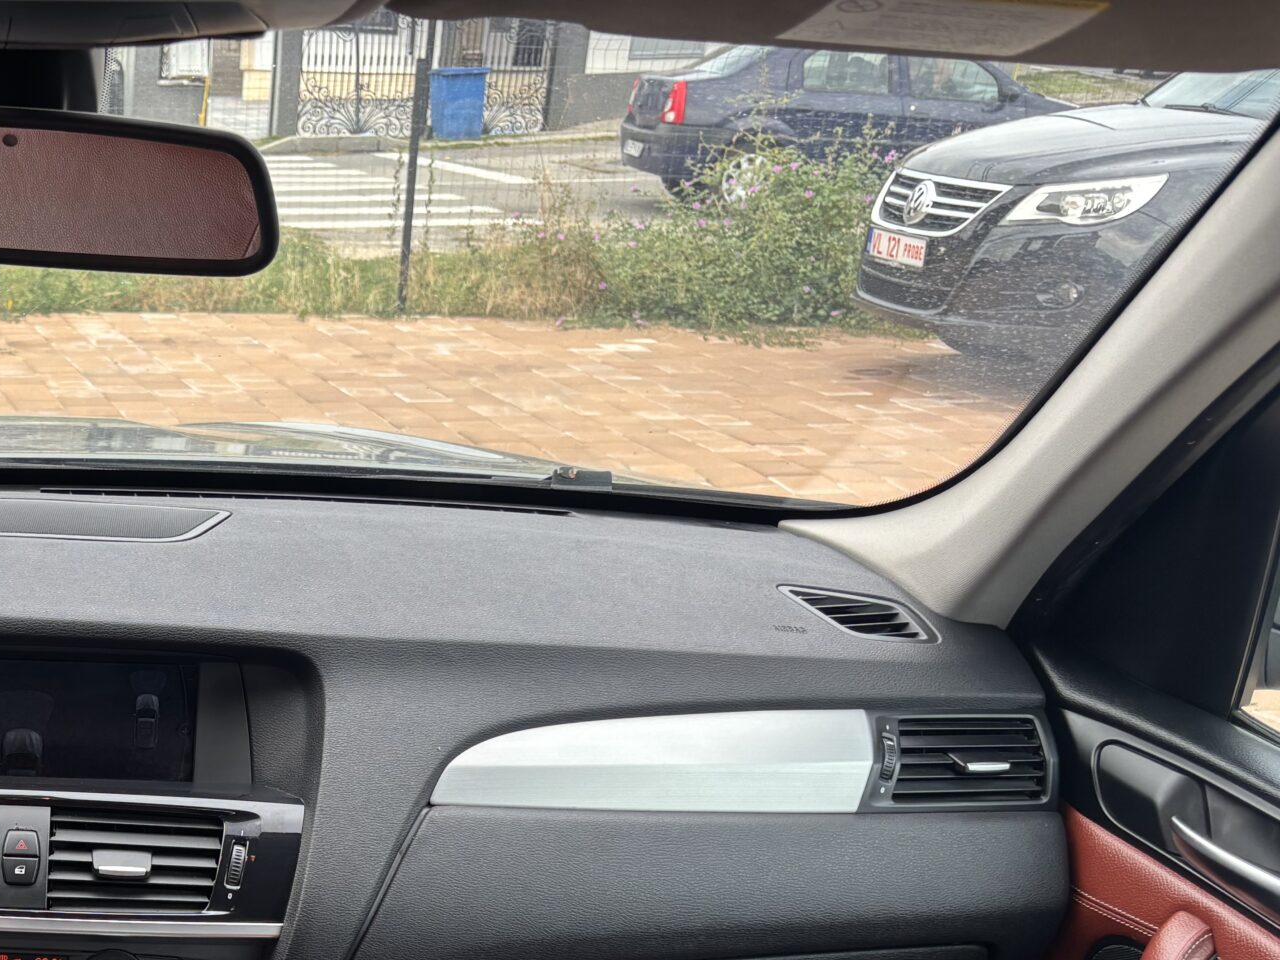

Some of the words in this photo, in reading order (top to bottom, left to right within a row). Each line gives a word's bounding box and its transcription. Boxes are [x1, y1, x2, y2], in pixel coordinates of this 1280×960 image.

[873, 232, 883, 255] VL
[887, 235, 900, 259] 121
[904, 243, 924, 261] PROBE
